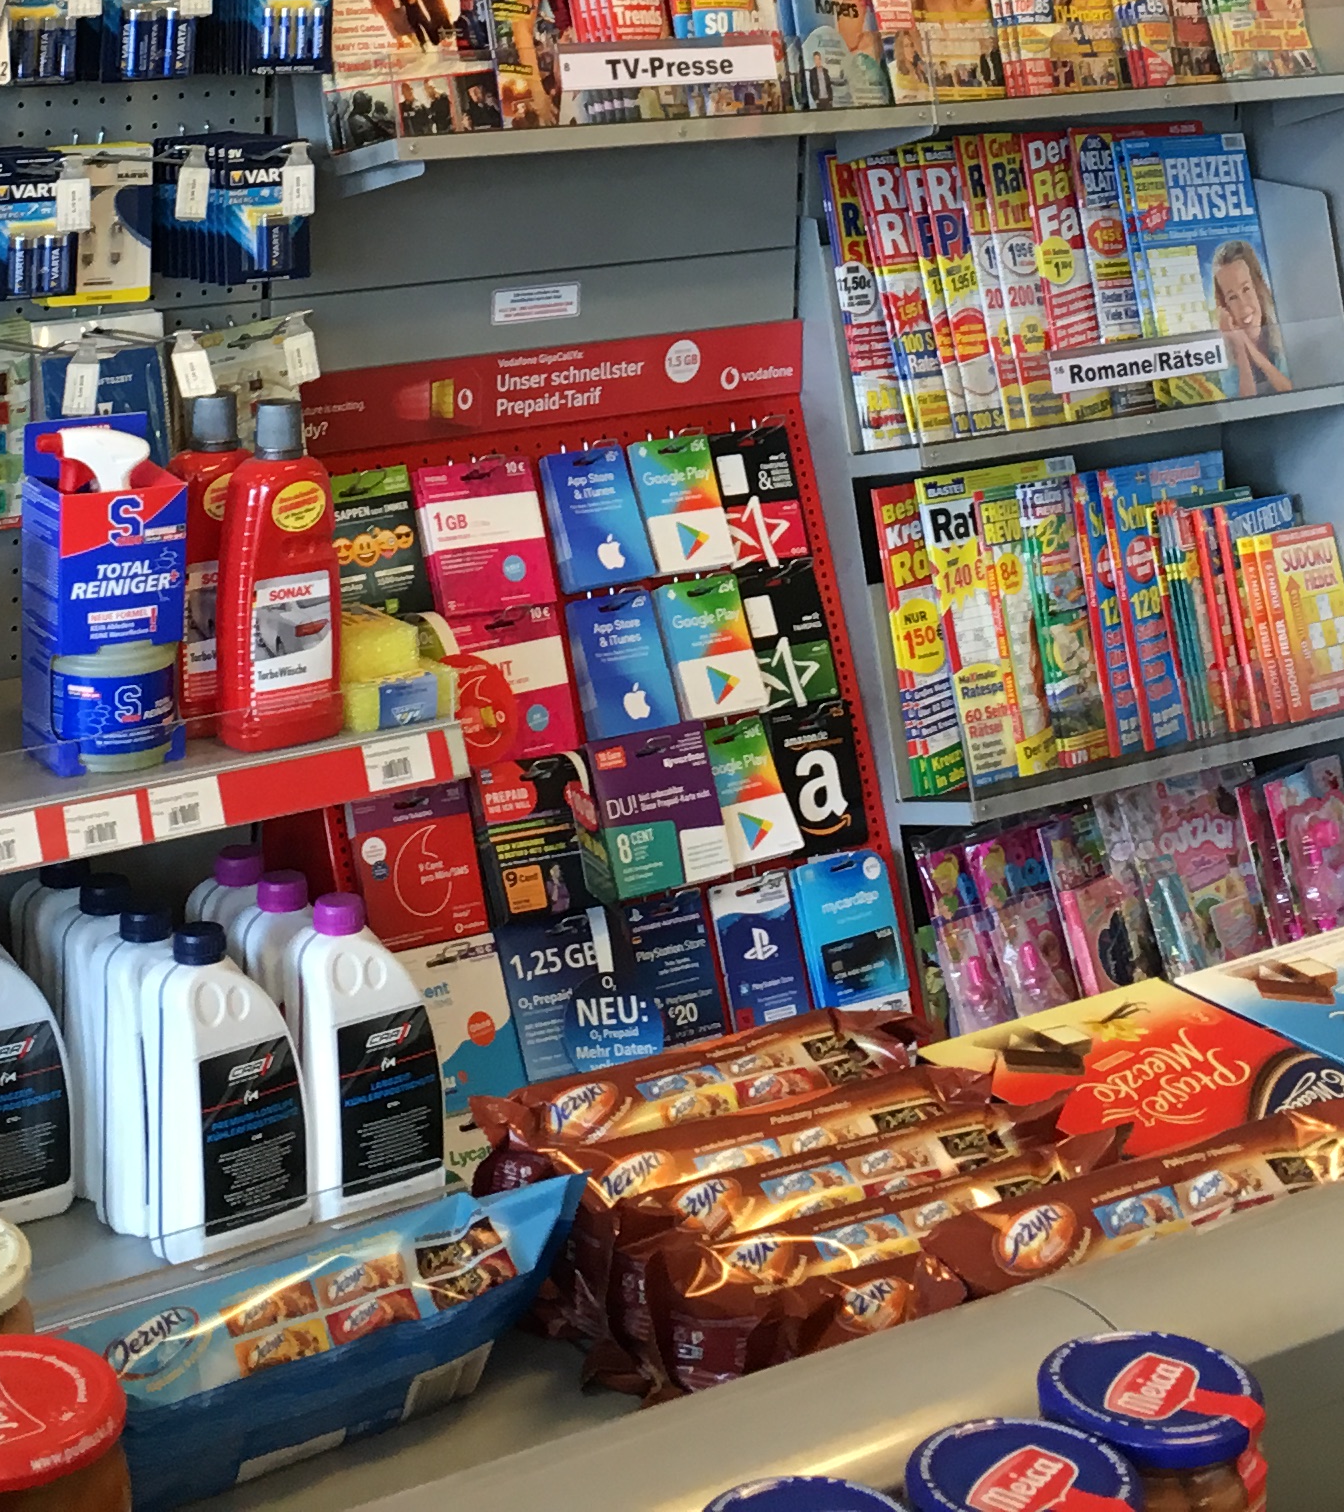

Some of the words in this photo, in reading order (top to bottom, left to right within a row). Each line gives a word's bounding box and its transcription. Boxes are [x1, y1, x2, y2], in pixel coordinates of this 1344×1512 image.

[612, 6, 661, 26] Trends
[605, 55, 734, 80] TV-Presse
[1166, 155, 1245, 185] FREIZEIT
[1169, 185, 1253, 221] RÄTSEL
[498, 356, 538, 367] Vodafone
[685, 352, 699, 367] GB
[1070, 345, 1222, 385] Romane/Rätsel
[496, 370, 547, 392] Unser
[550, 359, 644, 388] schnellster
[742, 364, 793, 382] vodafone
[496, 388, 601, 418] Prepaid-Tarif
[567, 474, 587, 487] App
[589, 470, 614, 485] Store
[644, 470, 685, 487] Google
[686, 467, 710, 484] Play
[97, 562, 152, 580] TOTAL
[999, 561, 1018, 580] 84
[1282, 551, 1333, 572] SUDOKU
[71, 576, 169, 598] REINIGER
[269, 585, 312, 601] SONAX
[593, 619, 614, 633] App
[616, 616, 641, 631] Store
[672, 611, 714, 629] Google
[716, 609, 740, 627] Play
[904, 611, 926, 623] NUR
[794, 749, 849, 819] a
[485, 788, 529, 805] PREPAID
[606, 797, 638, 819] DU!
[577, 994, 649, 1028] NEU:
[576, 1044, 609, 1059] Mehr
[612, 1039, 657, 1057] Daten-
[1118, 1364, 1182, 1416] Meica
[981, 1455, 1058, 1510] Meica
